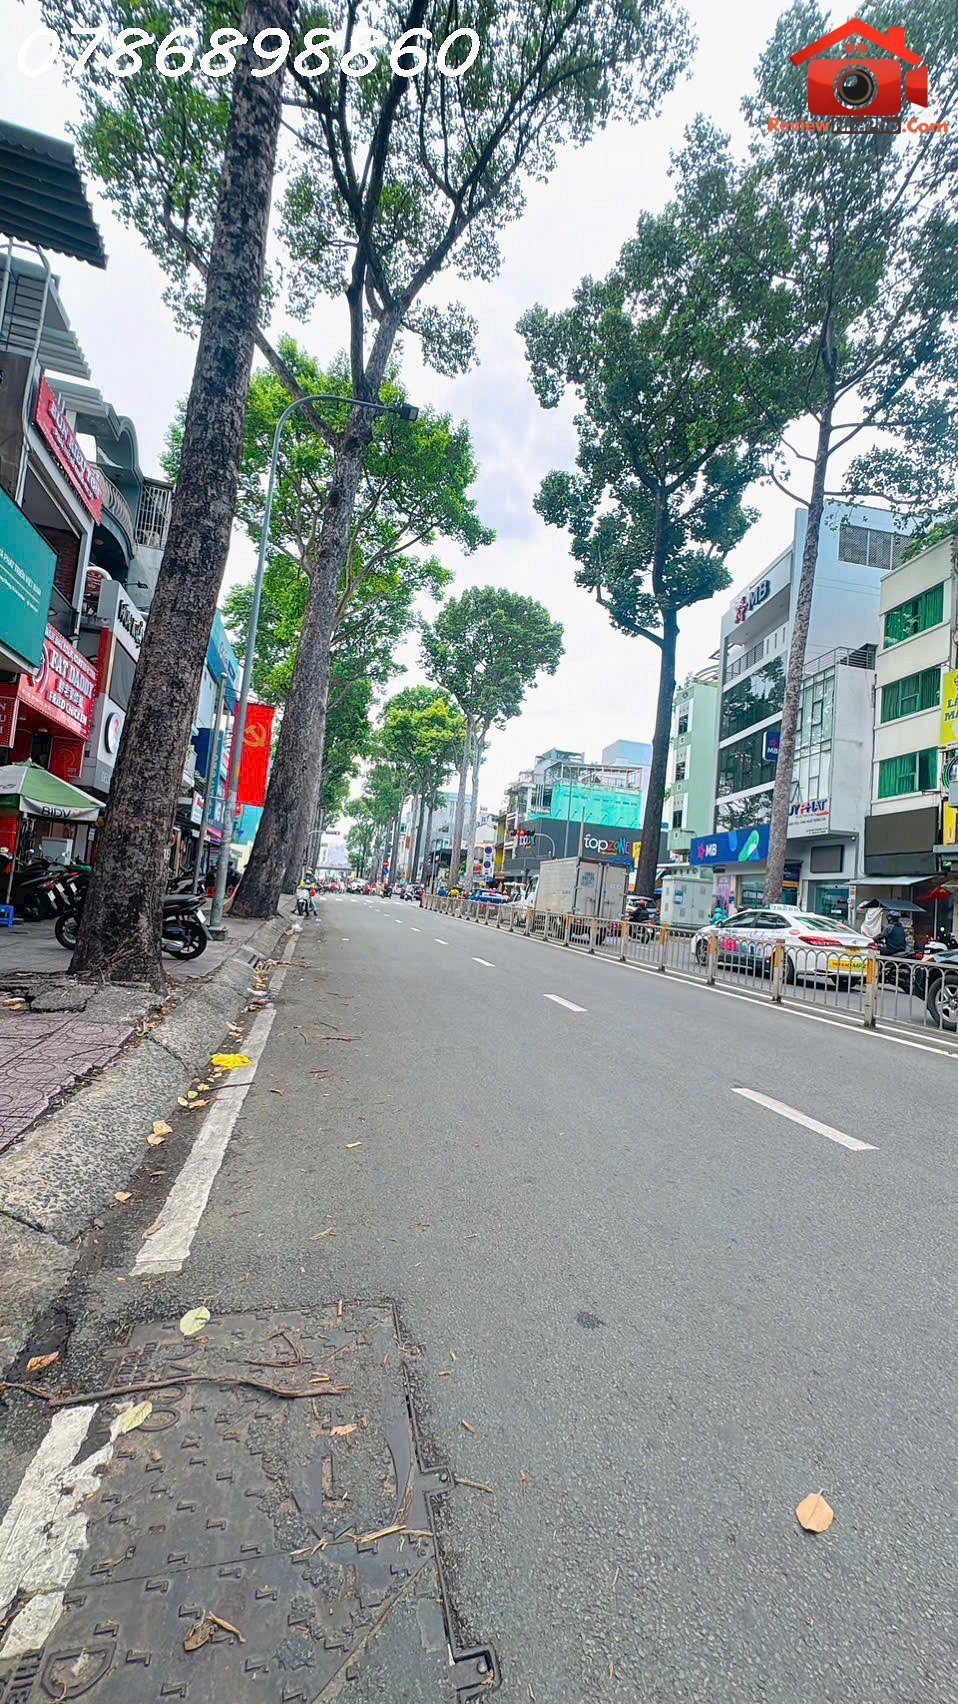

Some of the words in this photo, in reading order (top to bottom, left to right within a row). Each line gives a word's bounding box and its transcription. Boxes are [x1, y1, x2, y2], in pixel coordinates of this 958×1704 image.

[748, 580, 770, 611] MB
[42, 805, 72, 819] BIDV
[705, 843, 718, 857] MB
